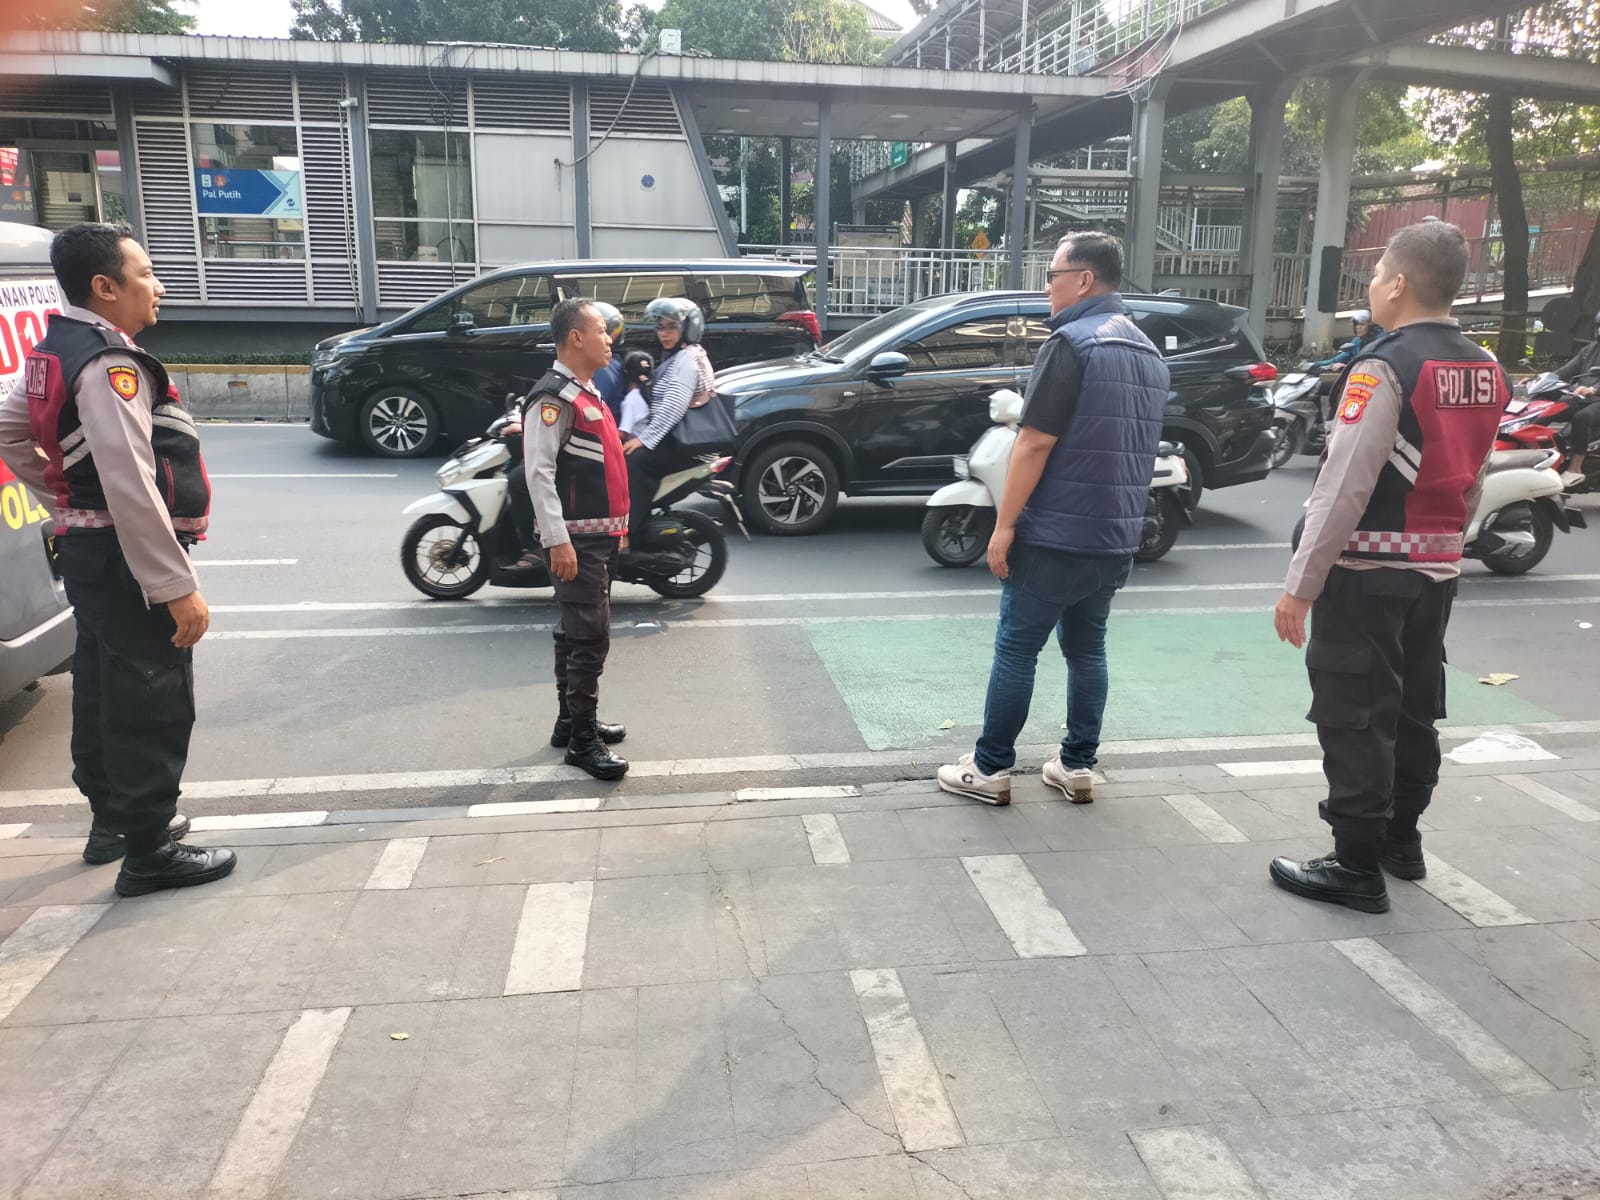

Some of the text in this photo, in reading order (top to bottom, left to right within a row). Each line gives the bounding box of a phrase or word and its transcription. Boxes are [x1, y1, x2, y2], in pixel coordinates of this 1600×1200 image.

[203, 189, 241, 199] Pal Putih
[28, 285, 60, 305] POLISI
[1437, 368, 1497, 405] POLISI
